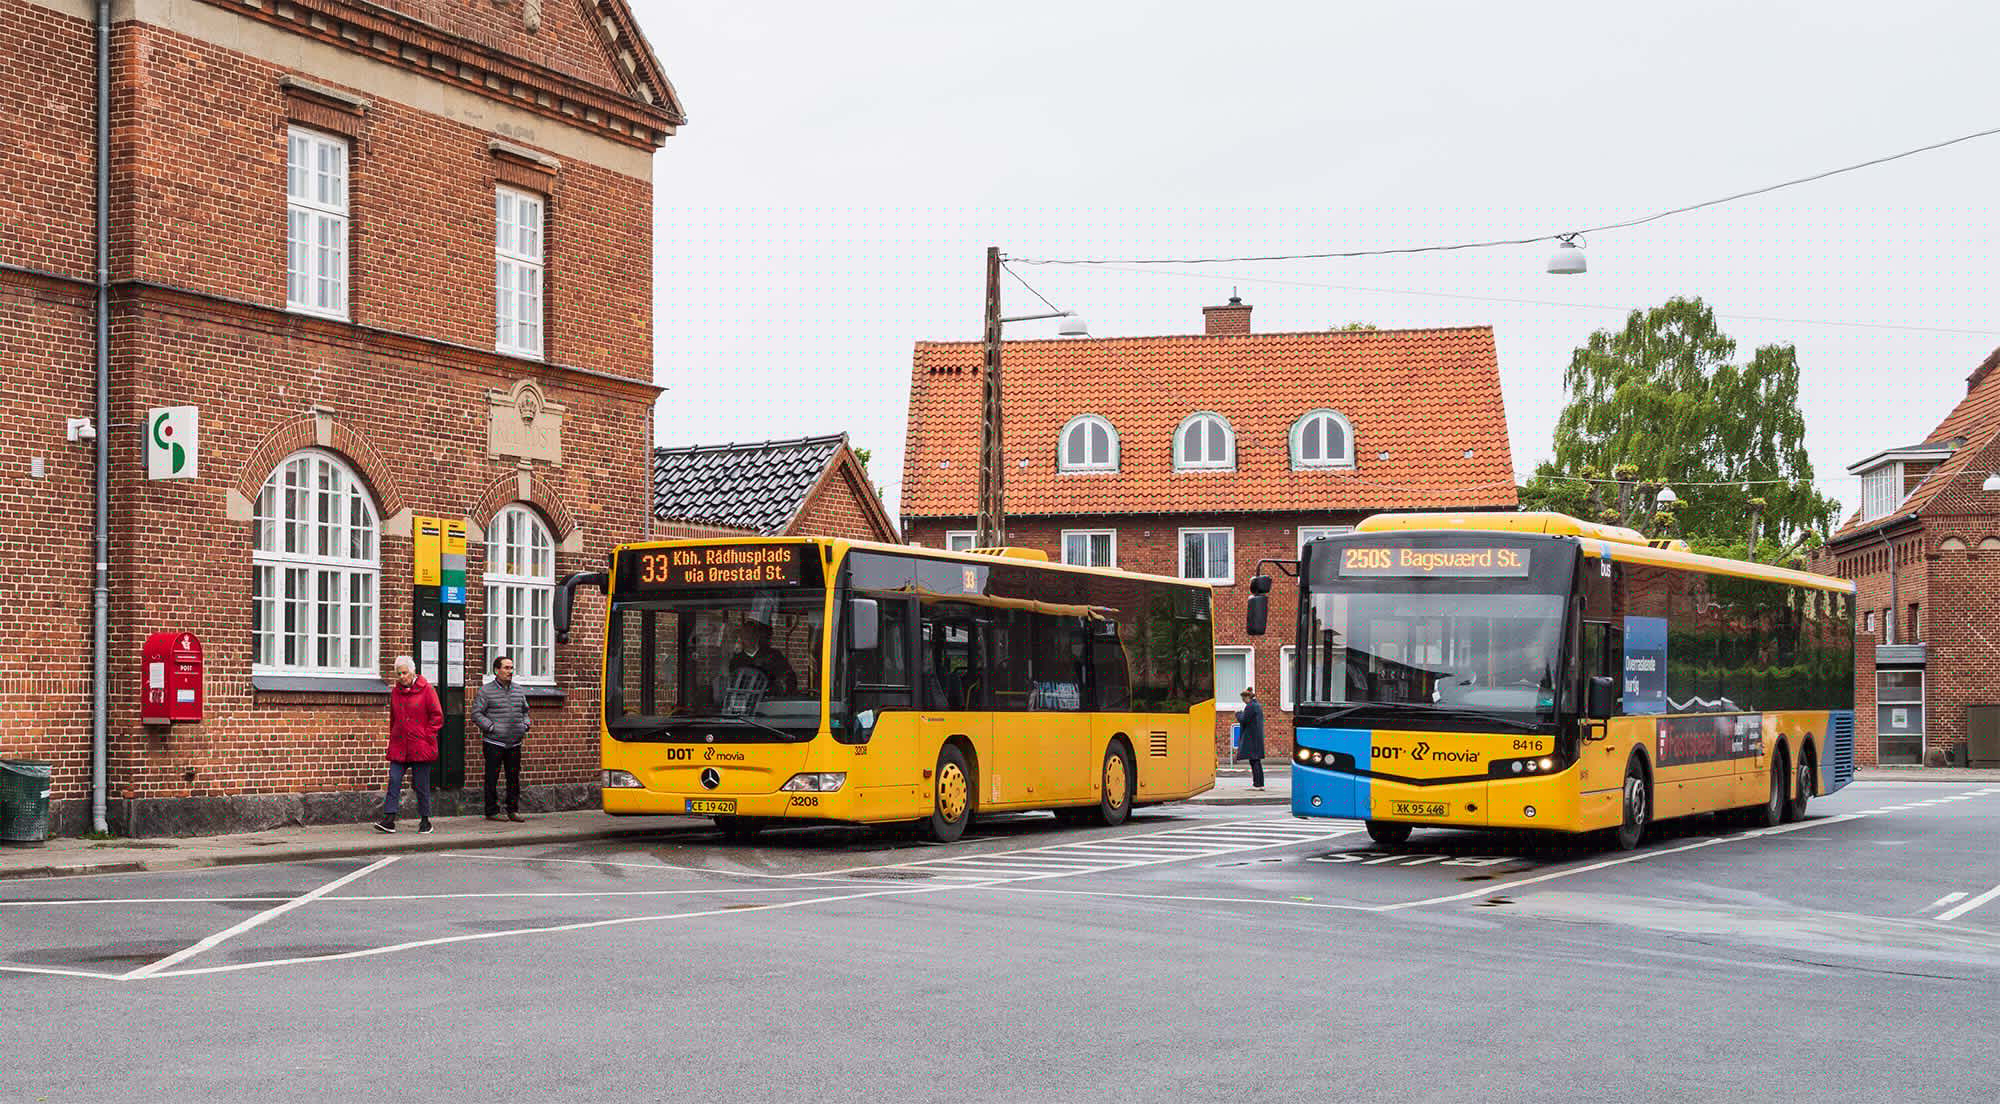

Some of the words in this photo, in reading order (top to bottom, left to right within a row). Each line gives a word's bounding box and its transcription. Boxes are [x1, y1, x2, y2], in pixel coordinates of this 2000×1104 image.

[673, 551, 701, 566] Kbh.
[706, 547, 791, 565] Rådhusplads
[1346, 549, 1392, 569] 250S
[1400, 549, 1492, 571] Bagsværd
[1497, 549, 1521, 567] St.
[642, 554, 668, 582] 33
[684, 568, 704, 582] via
[709, 566, 760, 582] Ørestad
[766, 565, 786, 580] St.
[180, 664, 193, 672] POST
[1512, 739, 1543, 751] 8416
[667, 748, 694, 761] DOT
[716, 750, 745, 761] movia
[1371, 746, 1403, 760] DOT
[1432, 749, 1479, 763] movia
[692, 801, 703, 812] CE
[706, 801, 716, 812] 19
[718, 801, 734, 812] 420
[791, 796, 819, 807] 3208
[1412, 803, 1424, 814] 95
